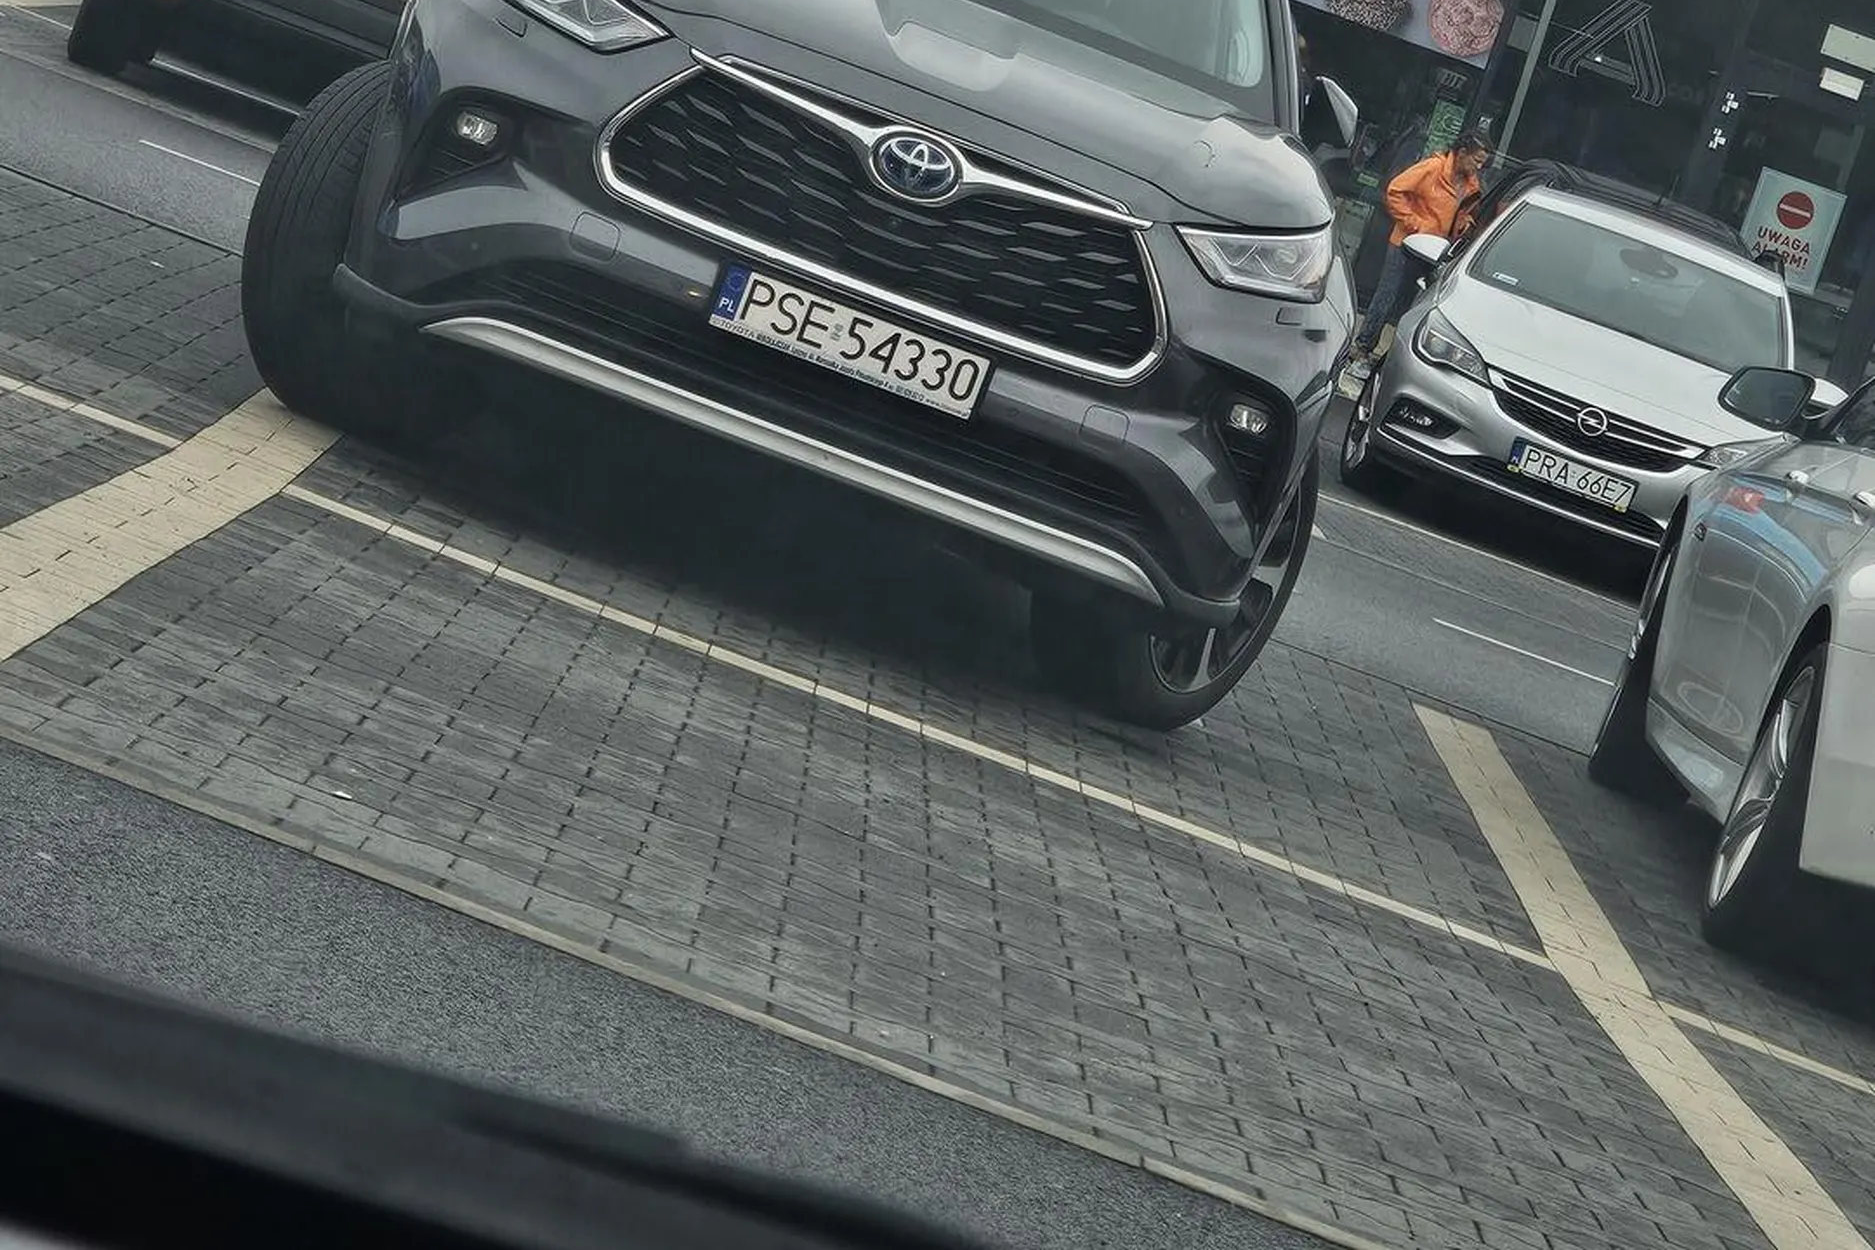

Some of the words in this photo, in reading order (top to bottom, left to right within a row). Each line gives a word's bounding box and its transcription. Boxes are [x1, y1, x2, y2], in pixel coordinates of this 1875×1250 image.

[1752, 240, 1810, 270] ALRM!
[1758, 226, 1810, 255] UWAGA
[719, 297, 735, 312] PL
[720, 319, 755, 339] TOYOTA
[740, 279, 836, 349] PSE
[839, 317, 980, 401] 54330
[1524, 449, 1569, 484] PRA
[1577, 471, 1632, 503] 66E7
